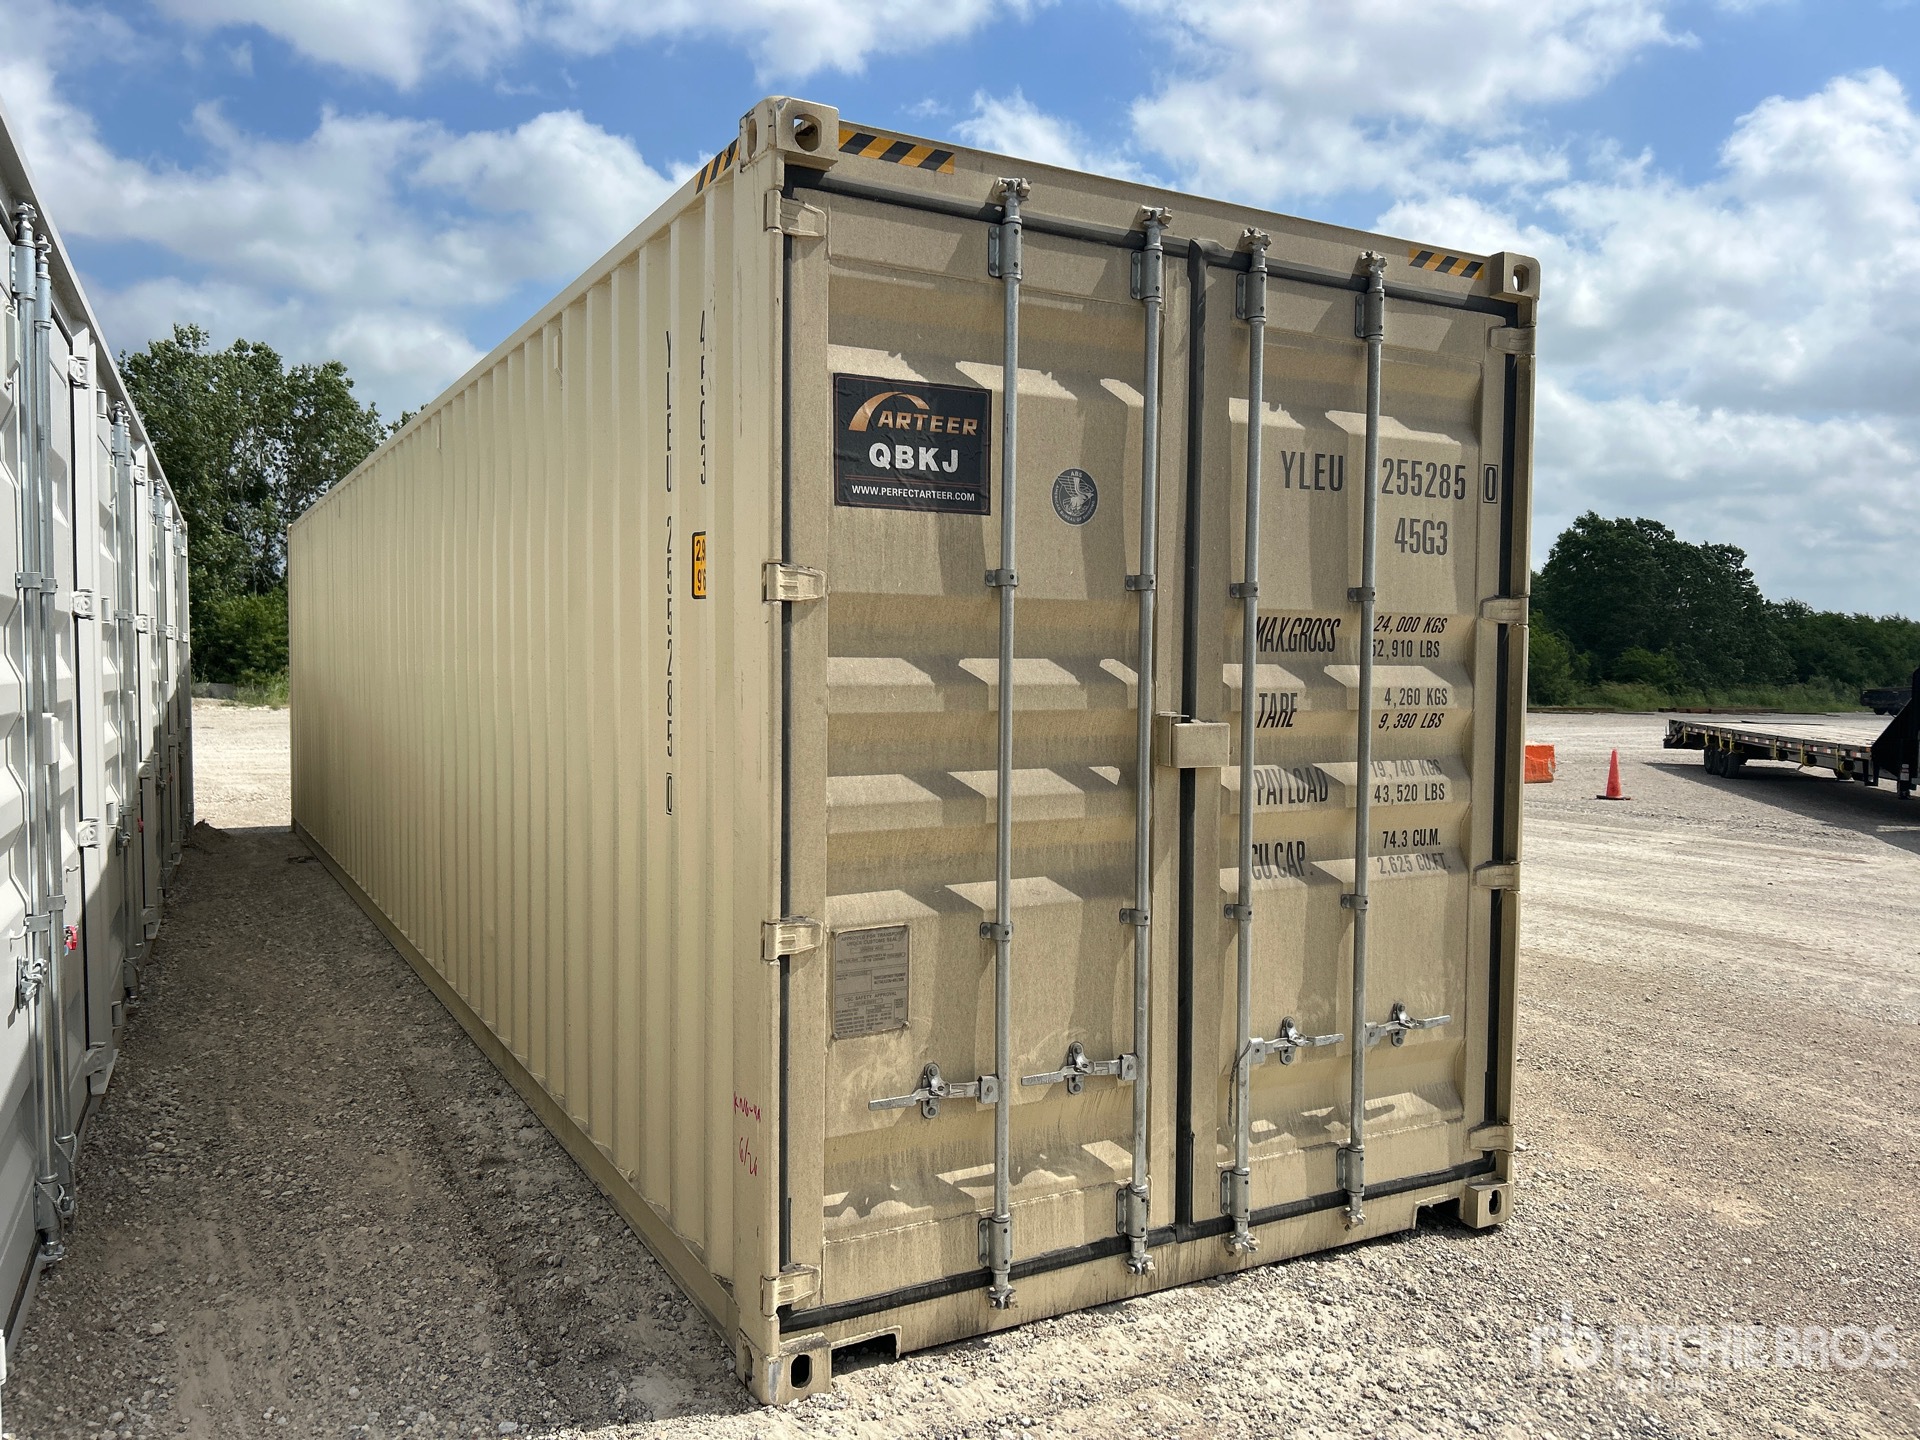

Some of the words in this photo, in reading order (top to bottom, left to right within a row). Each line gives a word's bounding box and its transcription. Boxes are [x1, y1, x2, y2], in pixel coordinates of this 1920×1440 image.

[878, 410, 978, 436] ARTEER
[869, 442, 959, 473] QBKJ
[1280, 450, 1344, 492] YLEU
[1381, 457, 1466, 500] 255285
[852, 484, 975, 502] WWW.PERFECTARTEER.COM
[1394, 517, 1448, 556] 45G3
[1256, 616, 1342, 653] MAX.GROSS
[1374, 615, 1421, 635] 24,000
[1423, 617, 1448, 634] KGS
[1420, 640, 1440, 658] LBS
[1384, 687, 1421, 709] 4,260
[1426, 688, 1448, 706] KGS
[1256, 692, 1298, 729] TARE
[1378, 713, 1418, 731] 9,390
[1420, 713, 1445, 729] LBS
[1371, 760, 1415, 780] 19,740
[1420, 759, 1443, 777] KGS
[1254, 767, 1329, 806] PAYLOAD
[1374, 784, 1418, 806] 43,520
[1424, 783, 1445, 801] LBS
[1382, 830, 1408, 849] 74.3
[1412, 828, 1441, 847] CU.M.
[1376, 854, 1413, 877] 2,625
